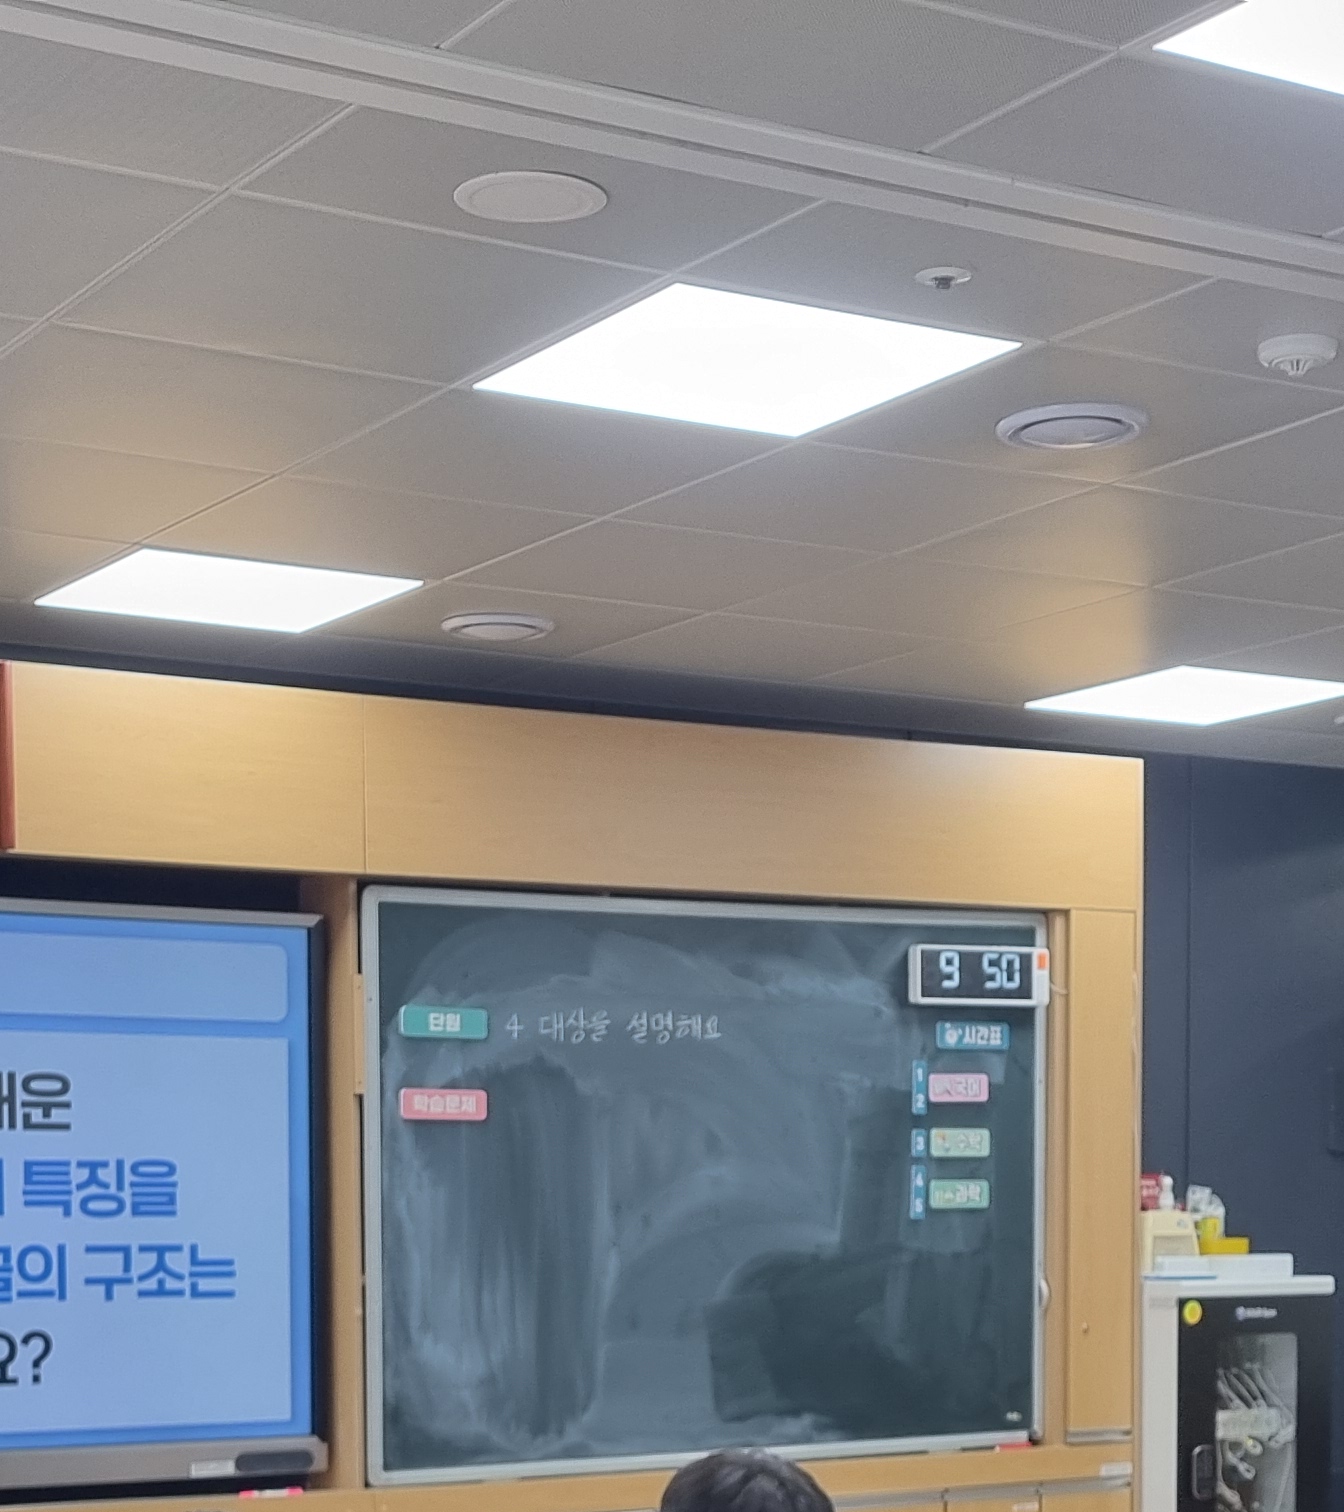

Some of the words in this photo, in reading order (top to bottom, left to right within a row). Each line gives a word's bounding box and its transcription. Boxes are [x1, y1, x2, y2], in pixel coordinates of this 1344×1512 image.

[939, 951, 960, 989] 9
[982, 952, 1021, 989] 50
[506, 1012, 524, 1040] 4
[538, 1007, 612, 1044] 대상을
[626, 1010, 722, 1045] 설명해요
[22, 1157, 179, 1219] 특징을
[84, 1241, 237, 1302] 구조는
